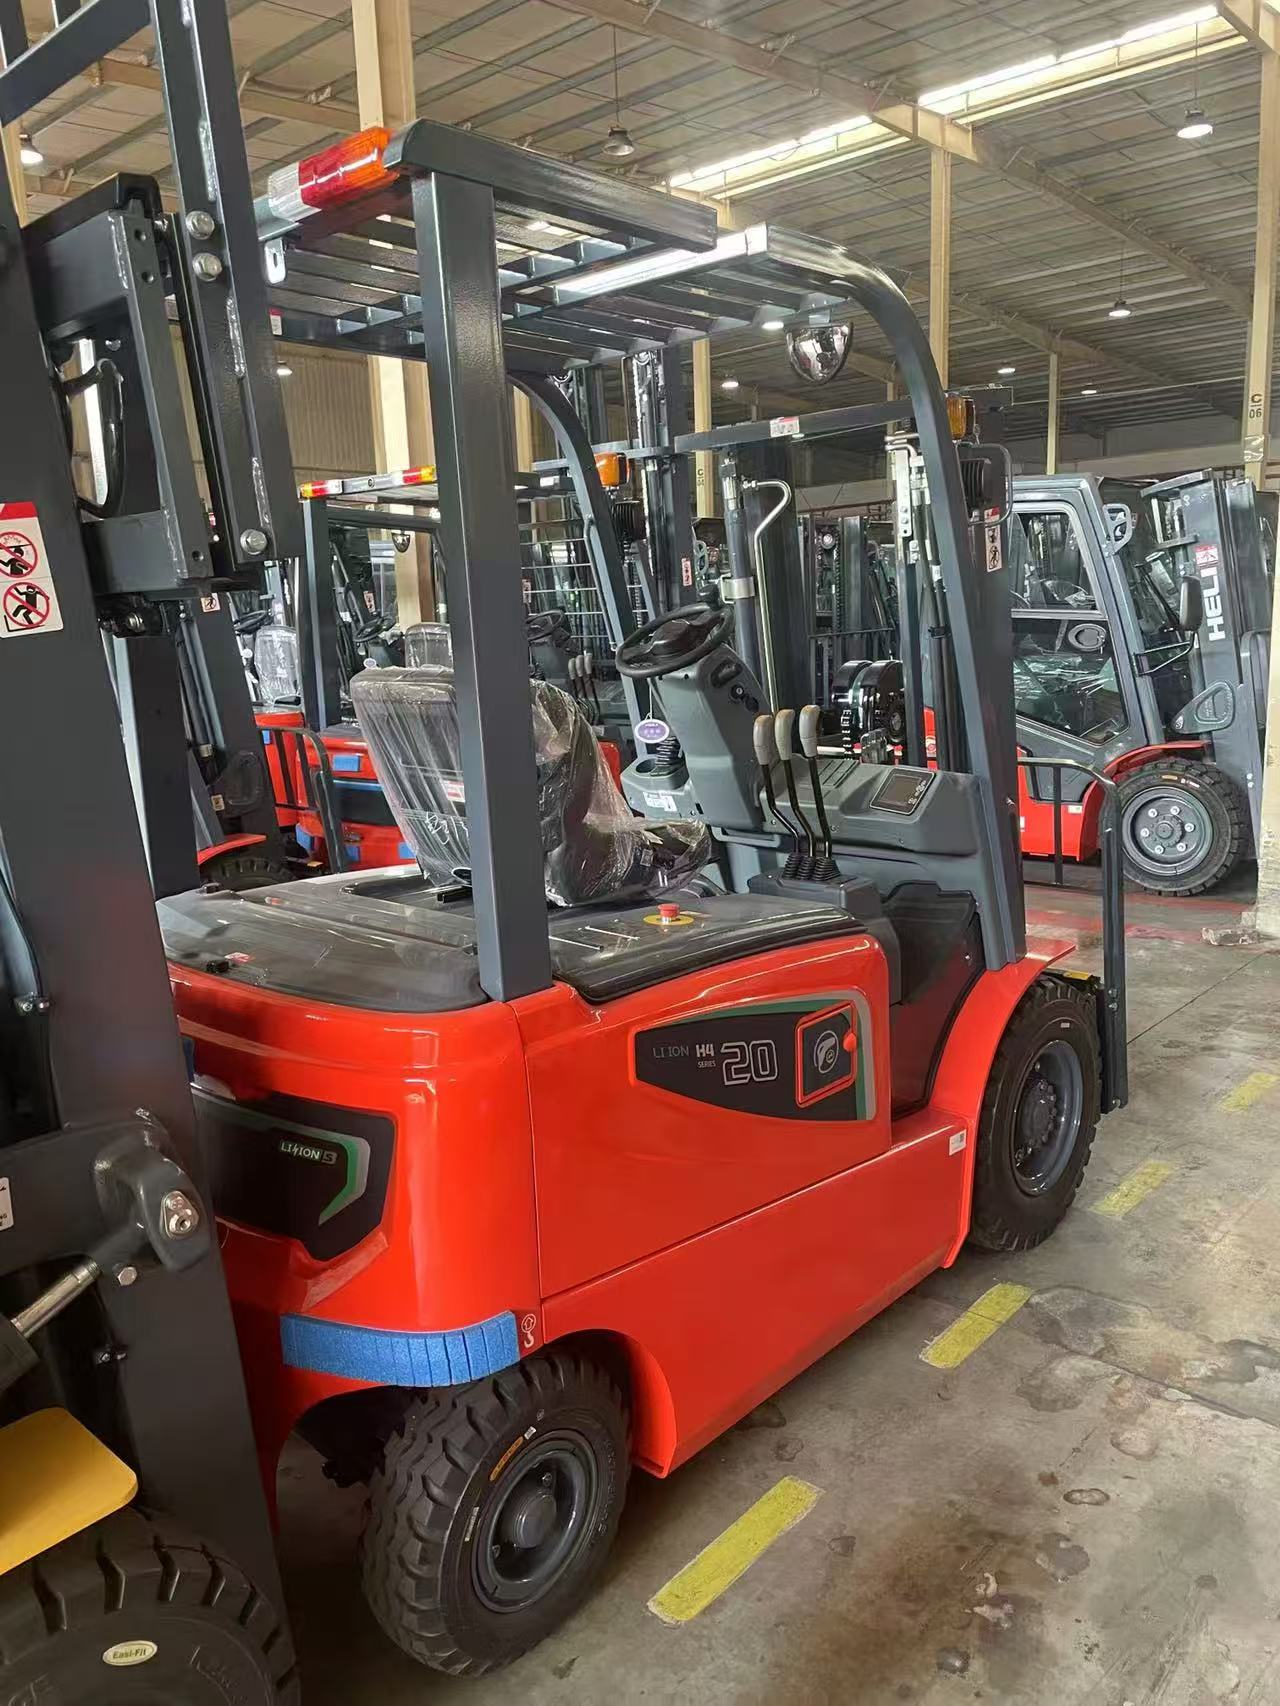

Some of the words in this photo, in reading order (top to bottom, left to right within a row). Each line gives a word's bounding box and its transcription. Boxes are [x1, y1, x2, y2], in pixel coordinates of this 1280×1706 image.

[1251, 393, 1262, 403] C
[1249, 408, 1262, 418] 06
[1200, 566, 1226, 641] HELI
[695, 1043, 715, 1058] H4
[720, 1039, 778, 1086] 20
[697, 1060, 717, 1069] SERIES
